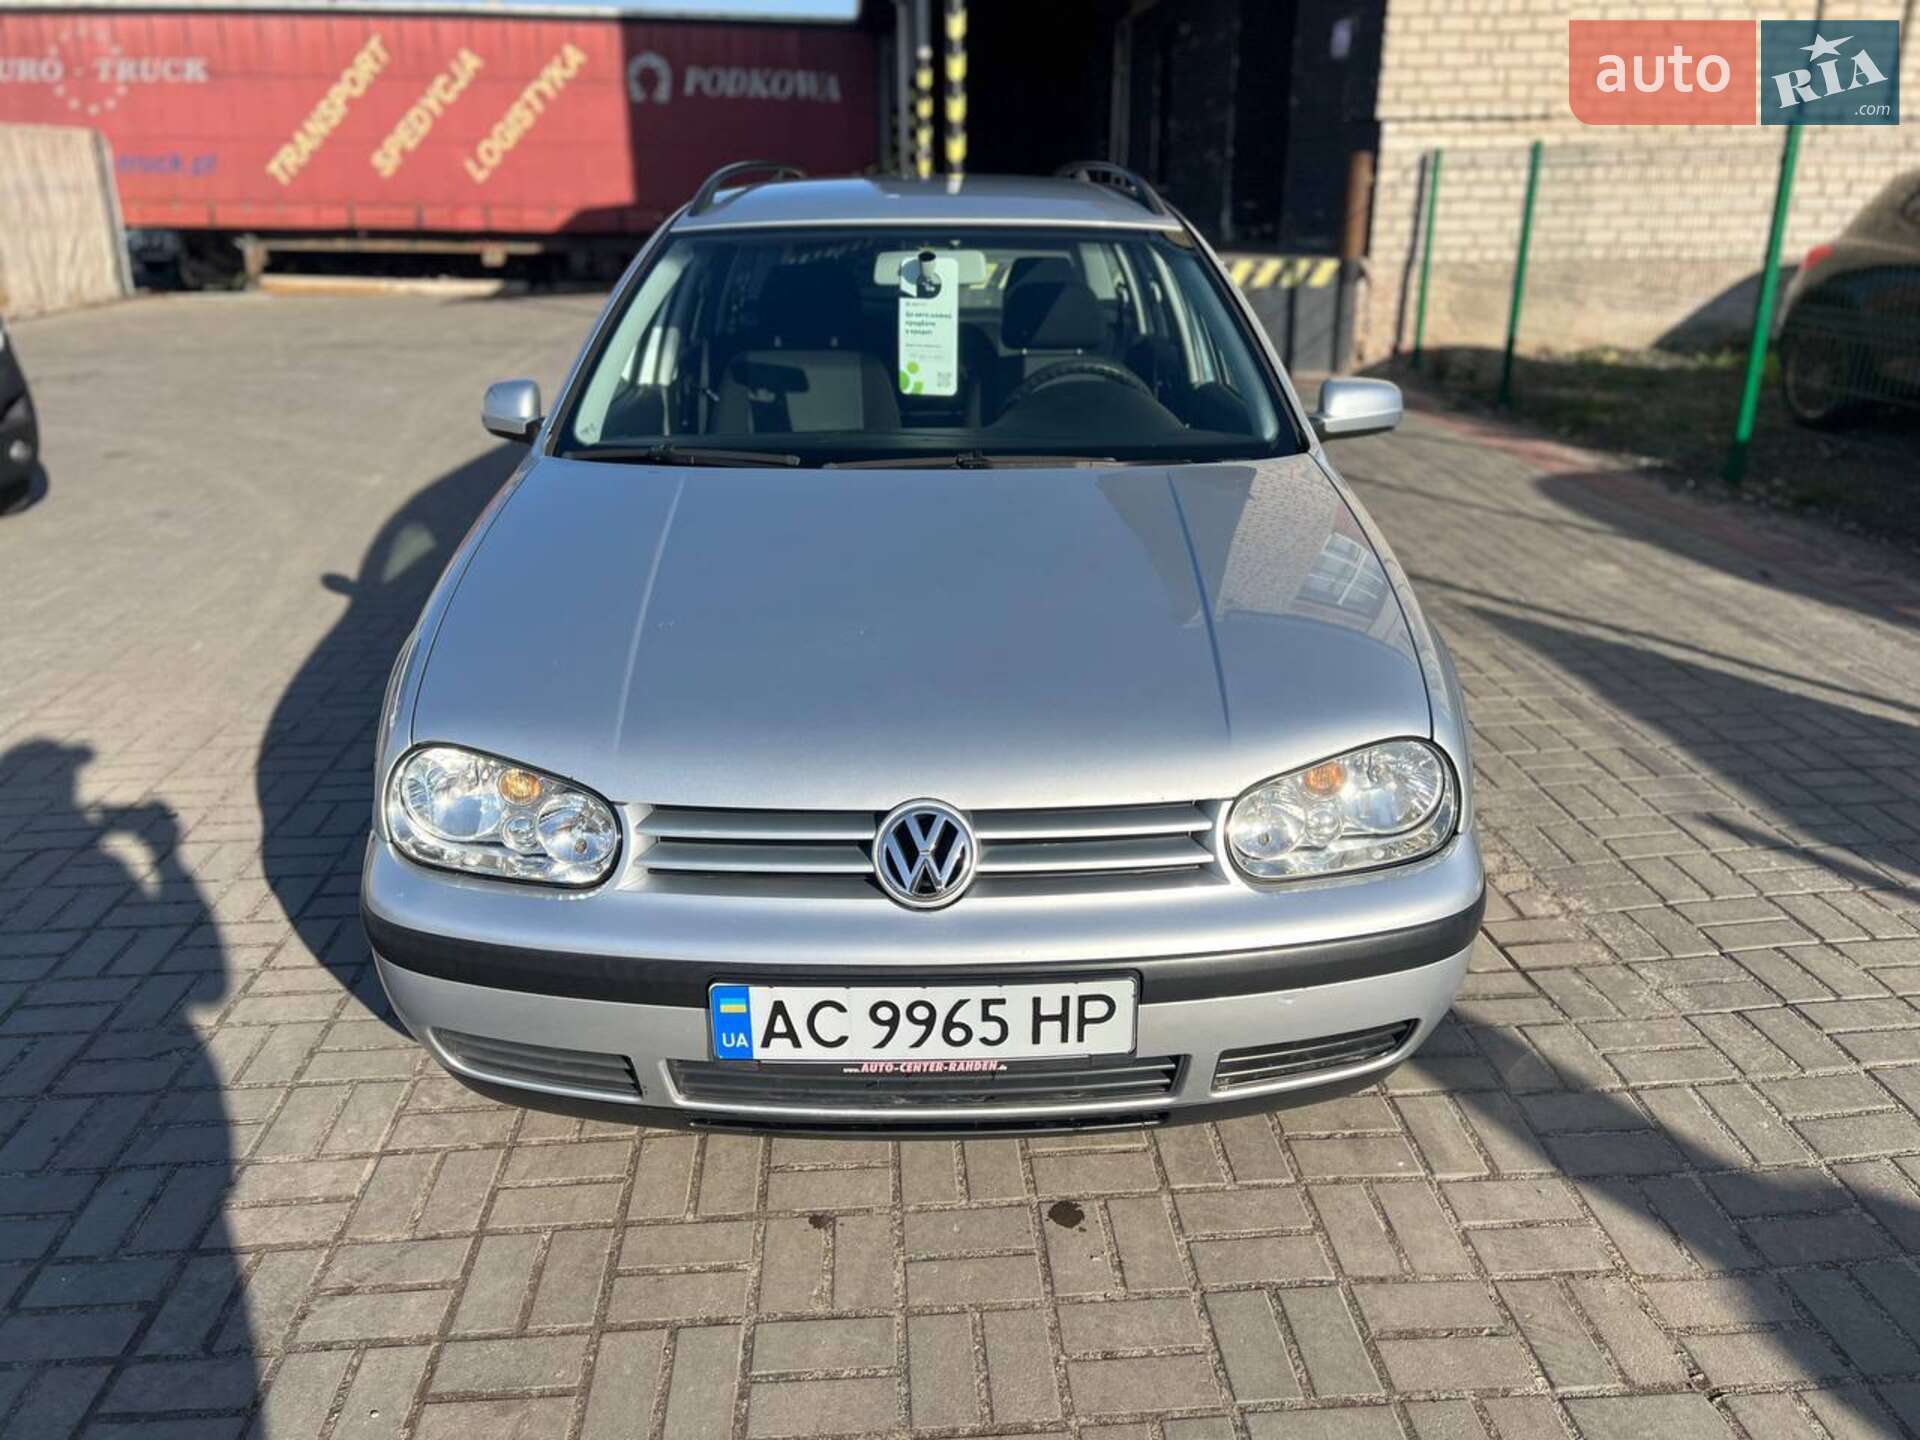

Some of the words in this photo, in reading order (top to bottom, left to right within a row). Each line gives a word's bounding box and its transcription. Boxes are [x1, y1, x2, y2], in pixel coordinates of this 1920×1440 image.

[95, 57, 209, 84] TRUCK
[266, 32, 390, 185] TRANSPORT
[371, 47, 485, 178] SPEDYCJA
[463, 42, 588, 184] LOGISTYKA
[683, 65, 841, 102] PODKOWA
[721, 1033, 750, 1049] UA
[760, 1000, 849, 1049] AC
[869, 998, 1009, 1050] 9965
[1031, 994, 1117, 1044] HP
